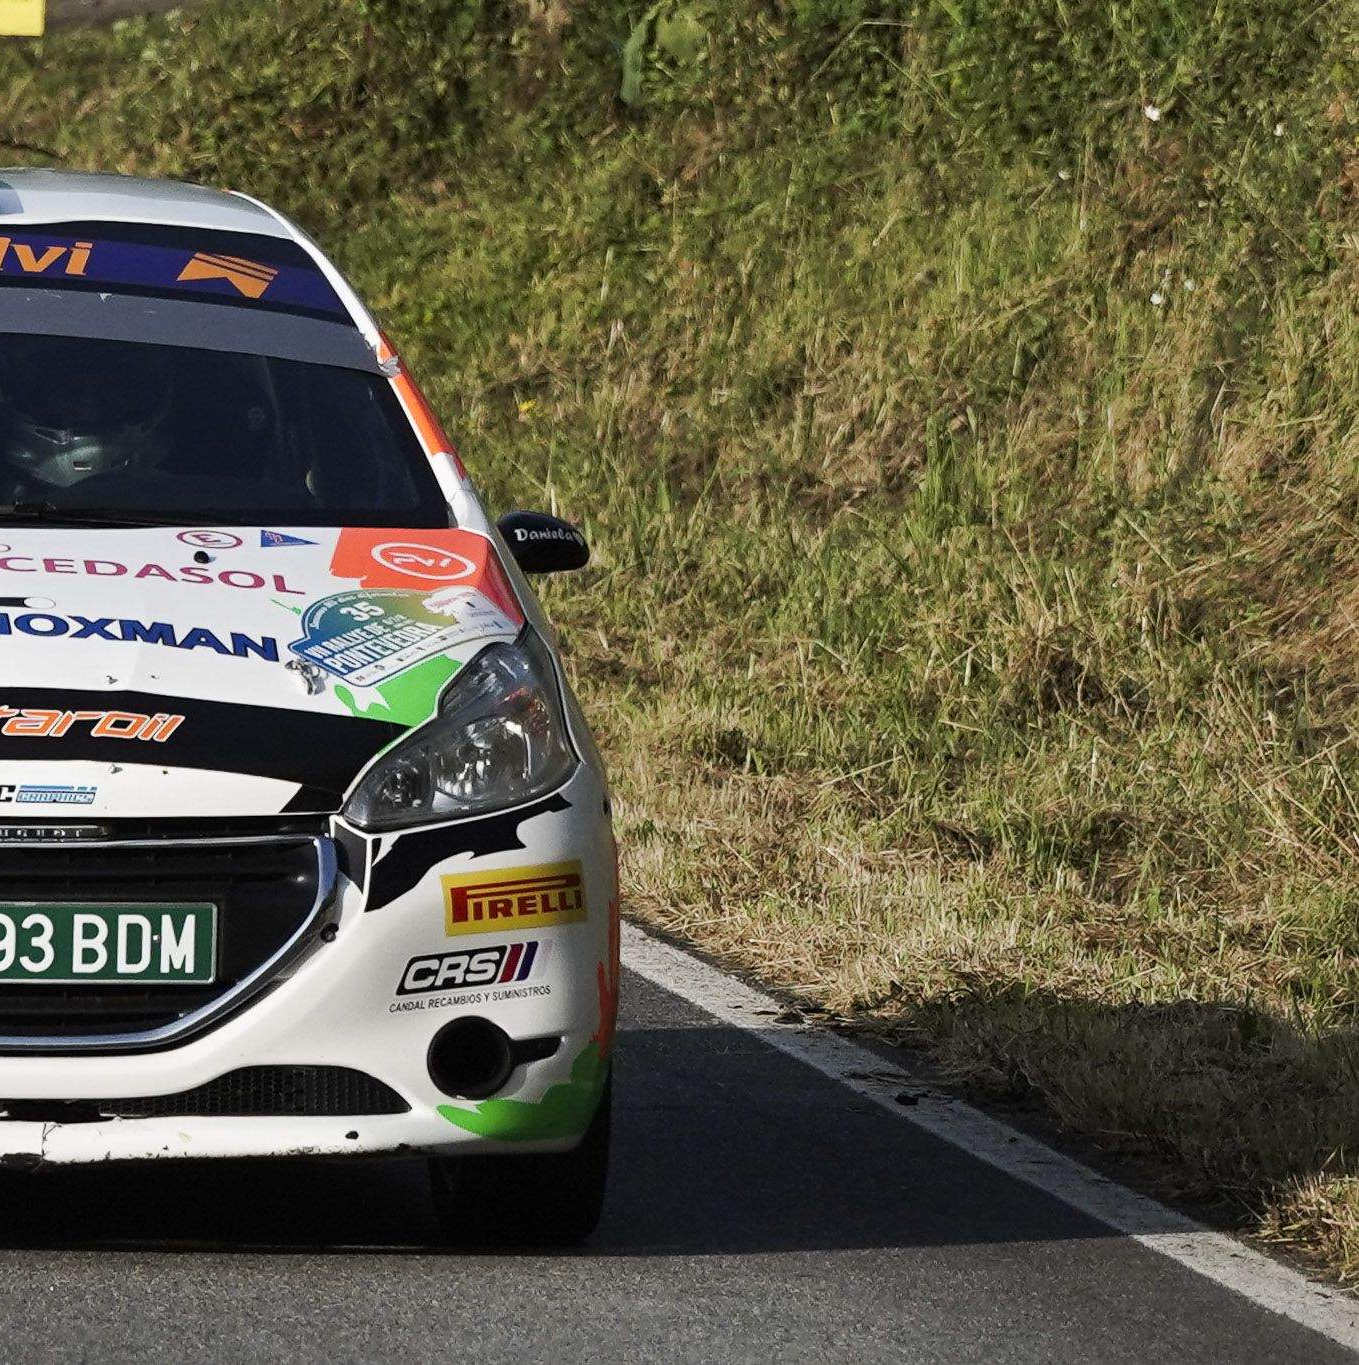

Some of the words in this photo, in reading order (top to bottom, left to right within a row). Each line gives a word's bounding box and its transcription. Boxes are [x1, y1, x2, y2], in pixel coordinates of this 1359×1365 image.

[514, 528, 574, 542] Daniela
[339, 600, 385, 622] 35
[322, 627, 376, 653] RALLYE
[322, 621, 442, 675] PONTEVEDRA
[449, 872, 582, 923] PIRELLI
[71, 912, 196, 974] BDM
[403, 951, 501, 990] CRS
[389, 1000, 425, 1013] CANDAL
[428, 993, 481, 1009] RECAMBIOS
[492, 985, 552, 1001] SUMINISTROS
